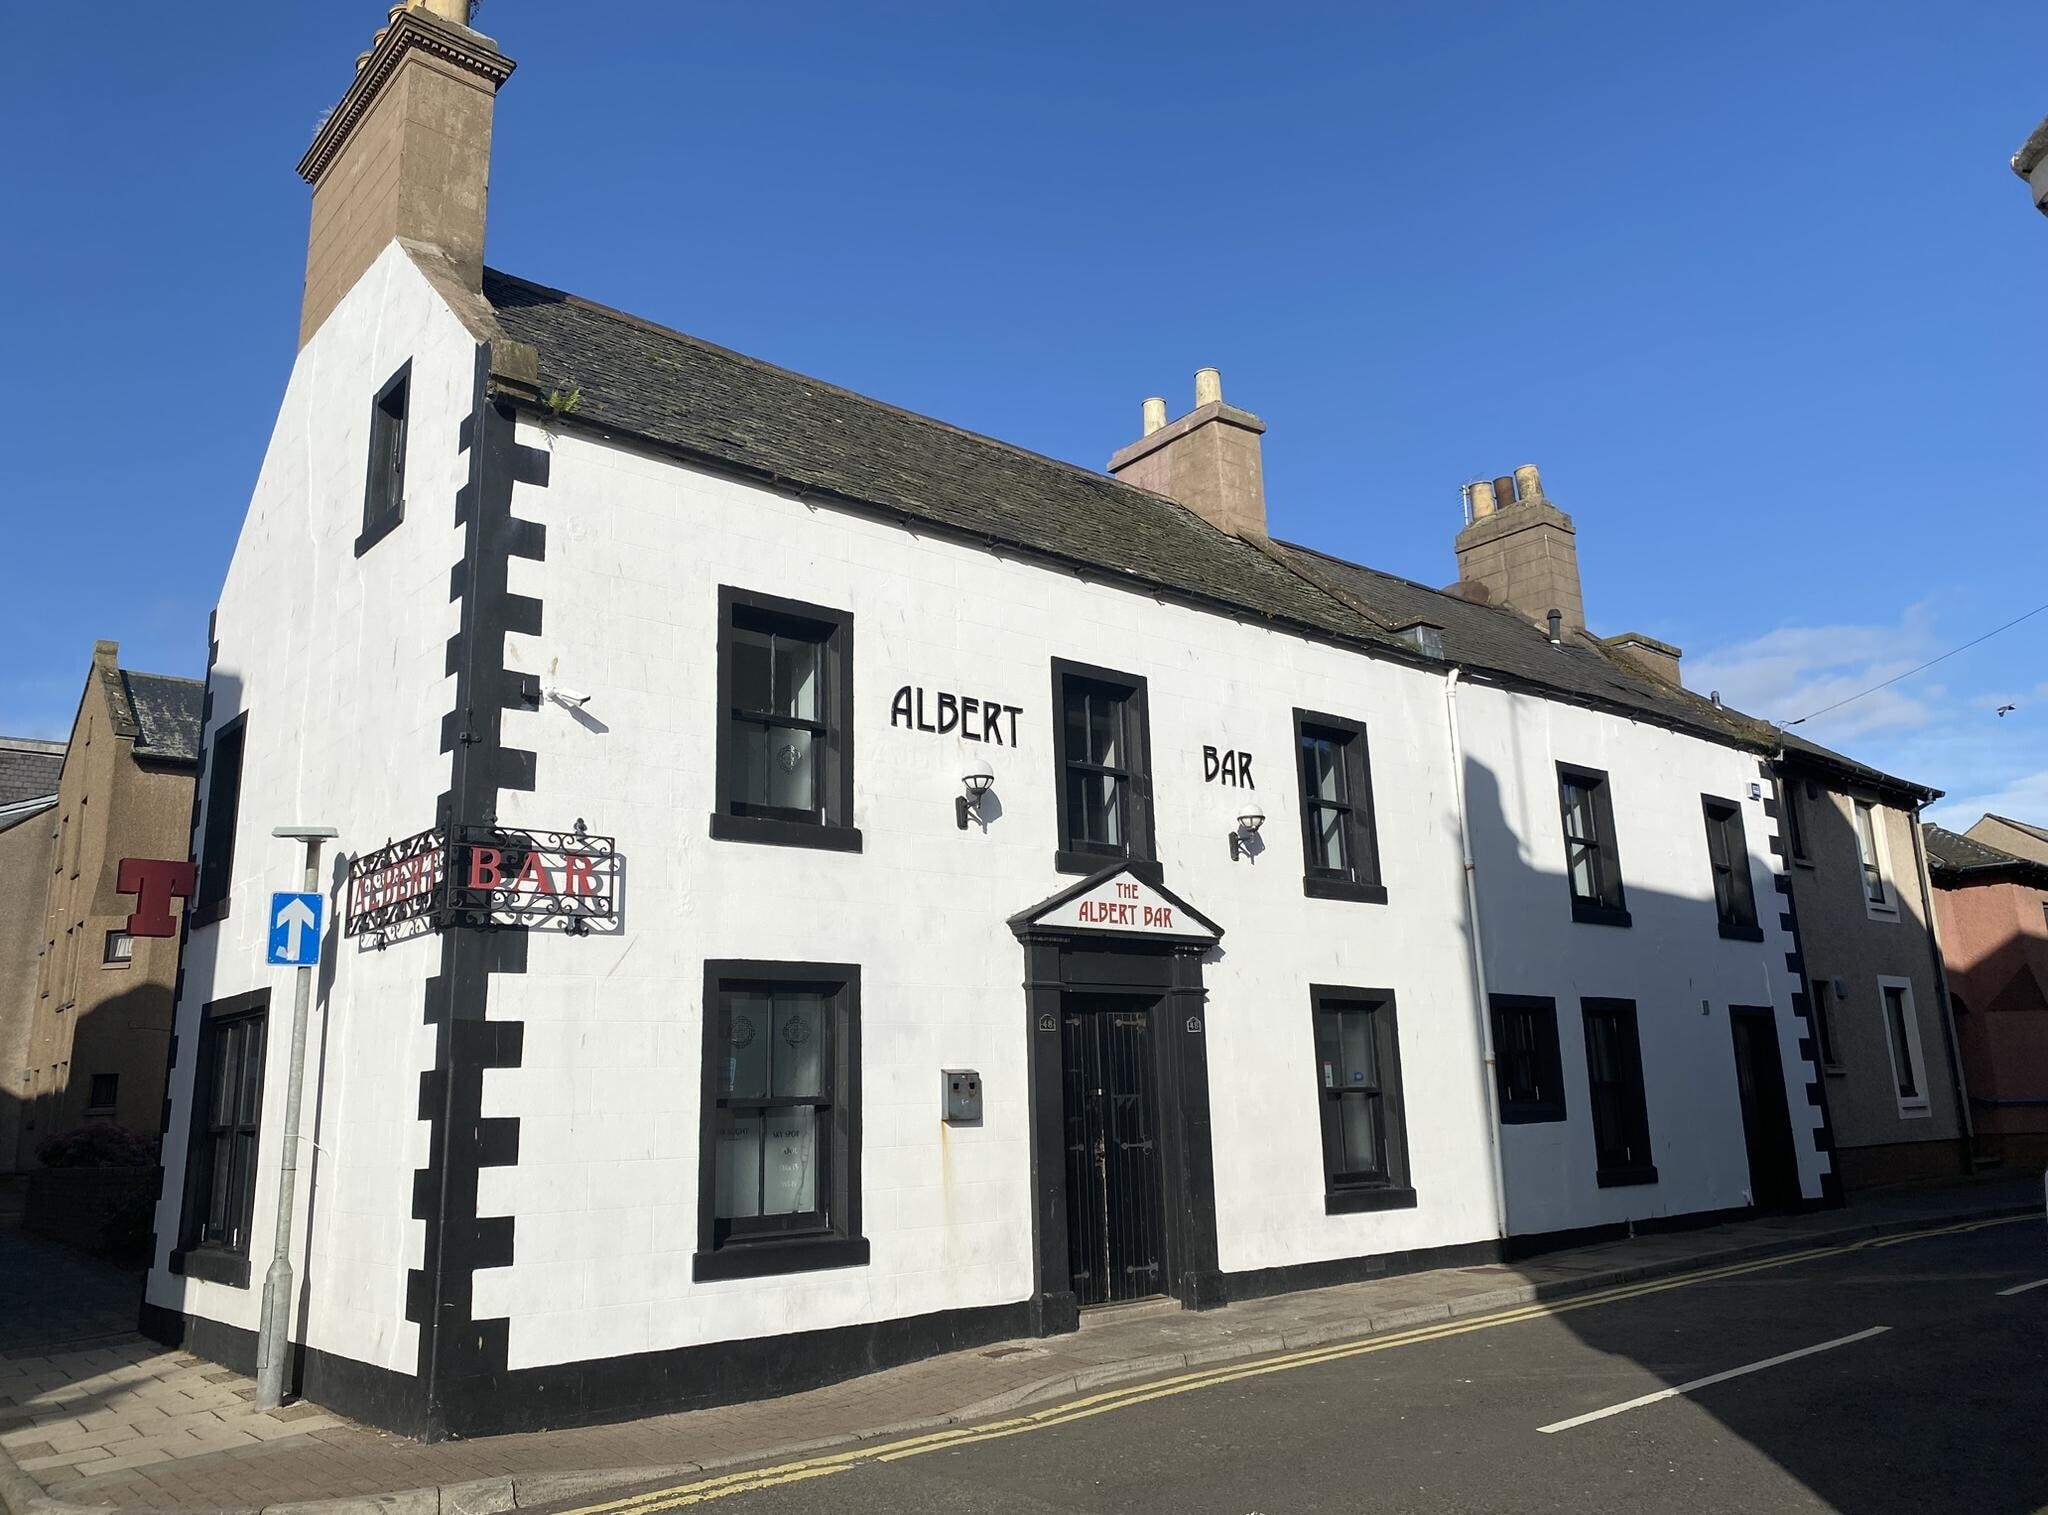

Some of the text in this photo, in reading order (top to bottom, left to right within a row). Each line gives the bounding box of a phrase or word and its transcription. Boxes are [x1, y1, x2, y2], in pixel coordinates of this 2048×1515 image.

[890, 685, 1023, 748] ALBERT
[1203, 745, 1255, 790] BAR
[350, 849, 440, 917] ALBERT
[468, 846, 594, 897] BAR
[1116, 883, 1139, 899] THE
[116, 857, 197, 938] T
[1079, 901, 1173, 928] ALBERT BAR
